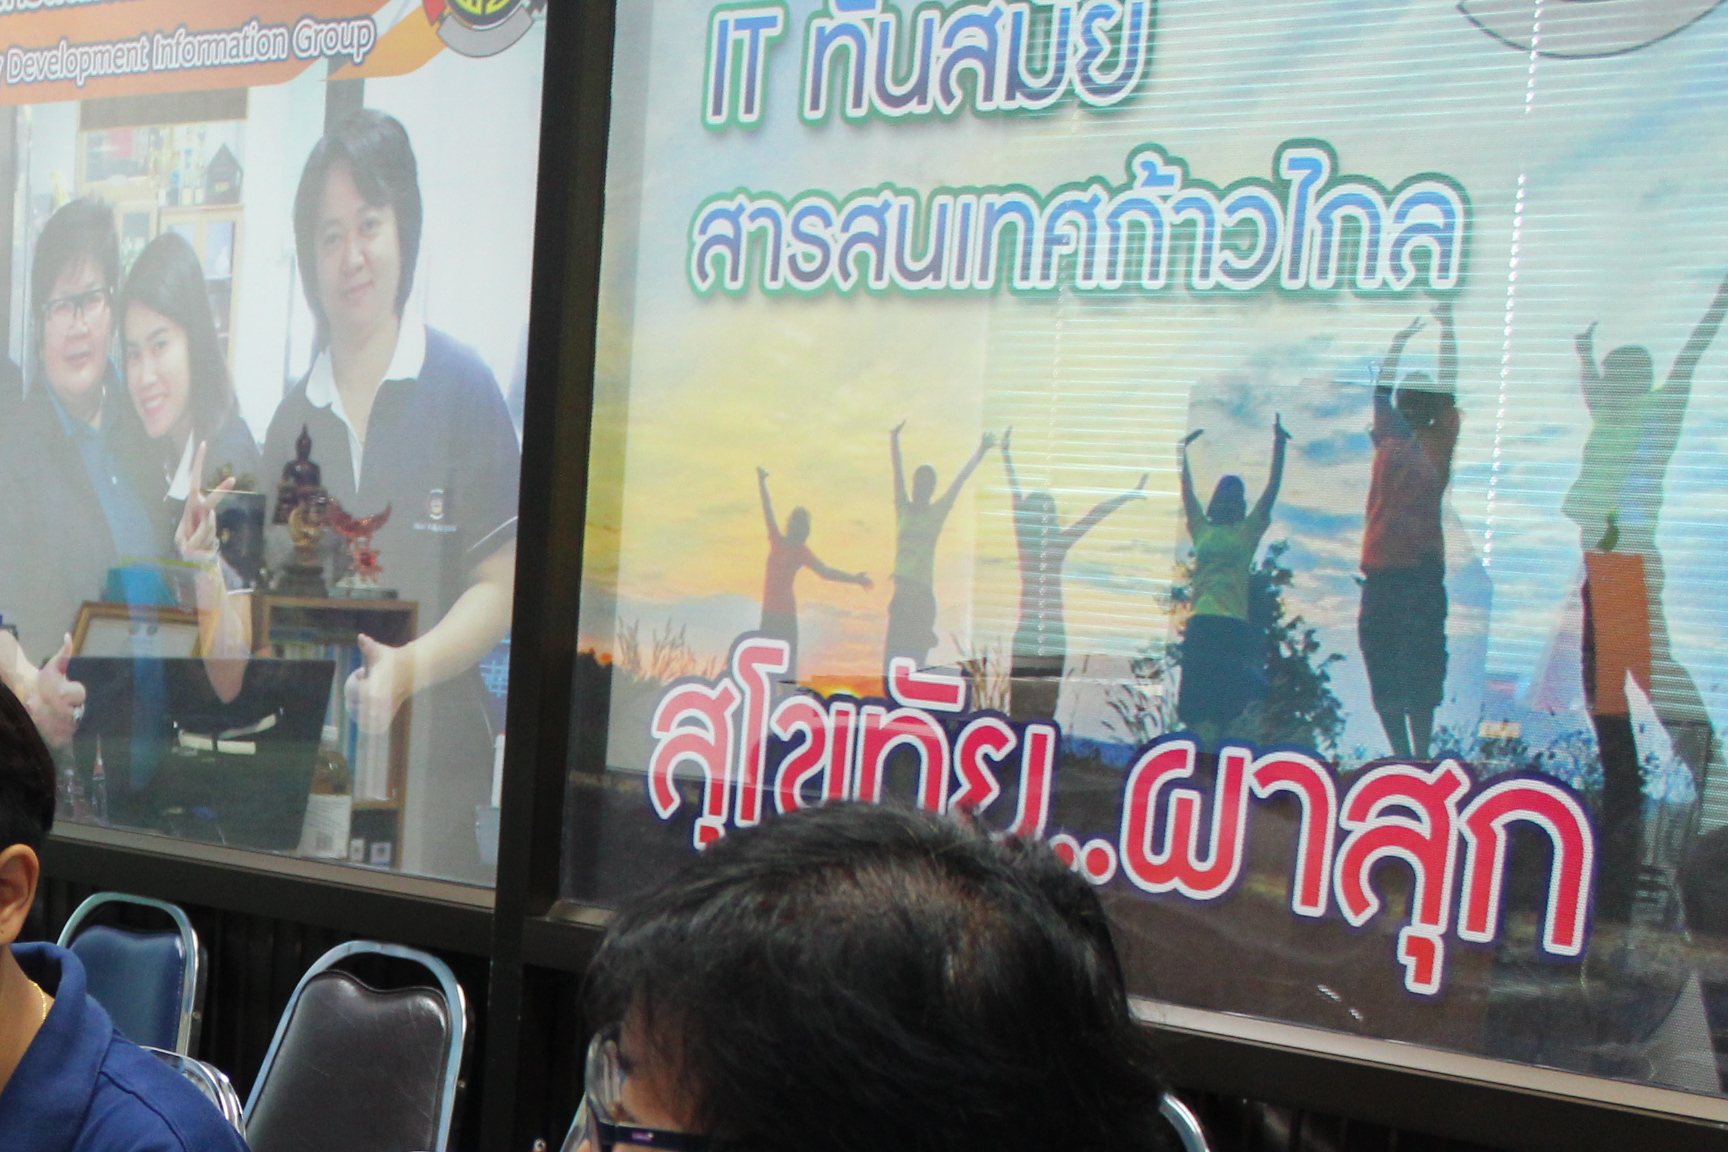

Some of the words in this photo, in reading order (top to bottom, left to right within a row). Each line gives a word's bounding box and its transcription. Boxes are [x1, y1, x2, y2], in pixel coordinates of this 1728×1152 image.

[7, 38, 148, 85] Development
[153, 22, 288, 70] Information
[293, 16, 376, 66] Group
[706, 8, 784, 124] IT
